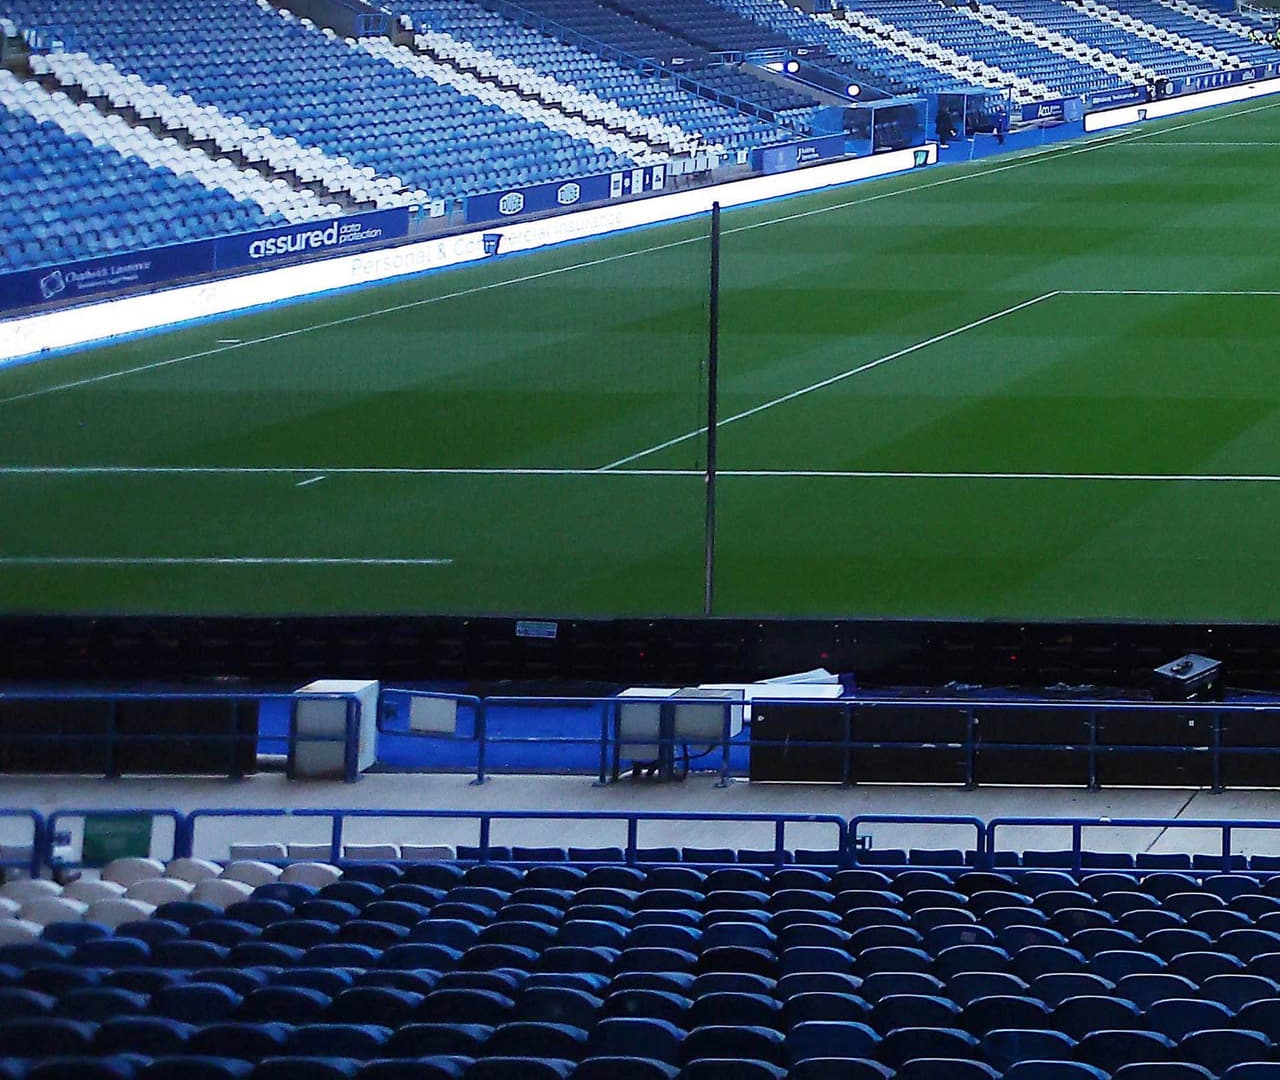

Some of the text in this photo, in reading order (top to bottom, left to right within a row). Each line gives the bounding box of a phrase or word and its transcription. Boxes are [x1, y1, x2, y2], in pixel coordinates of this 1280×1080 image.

[249, 221, 382, 259] assured data protection
